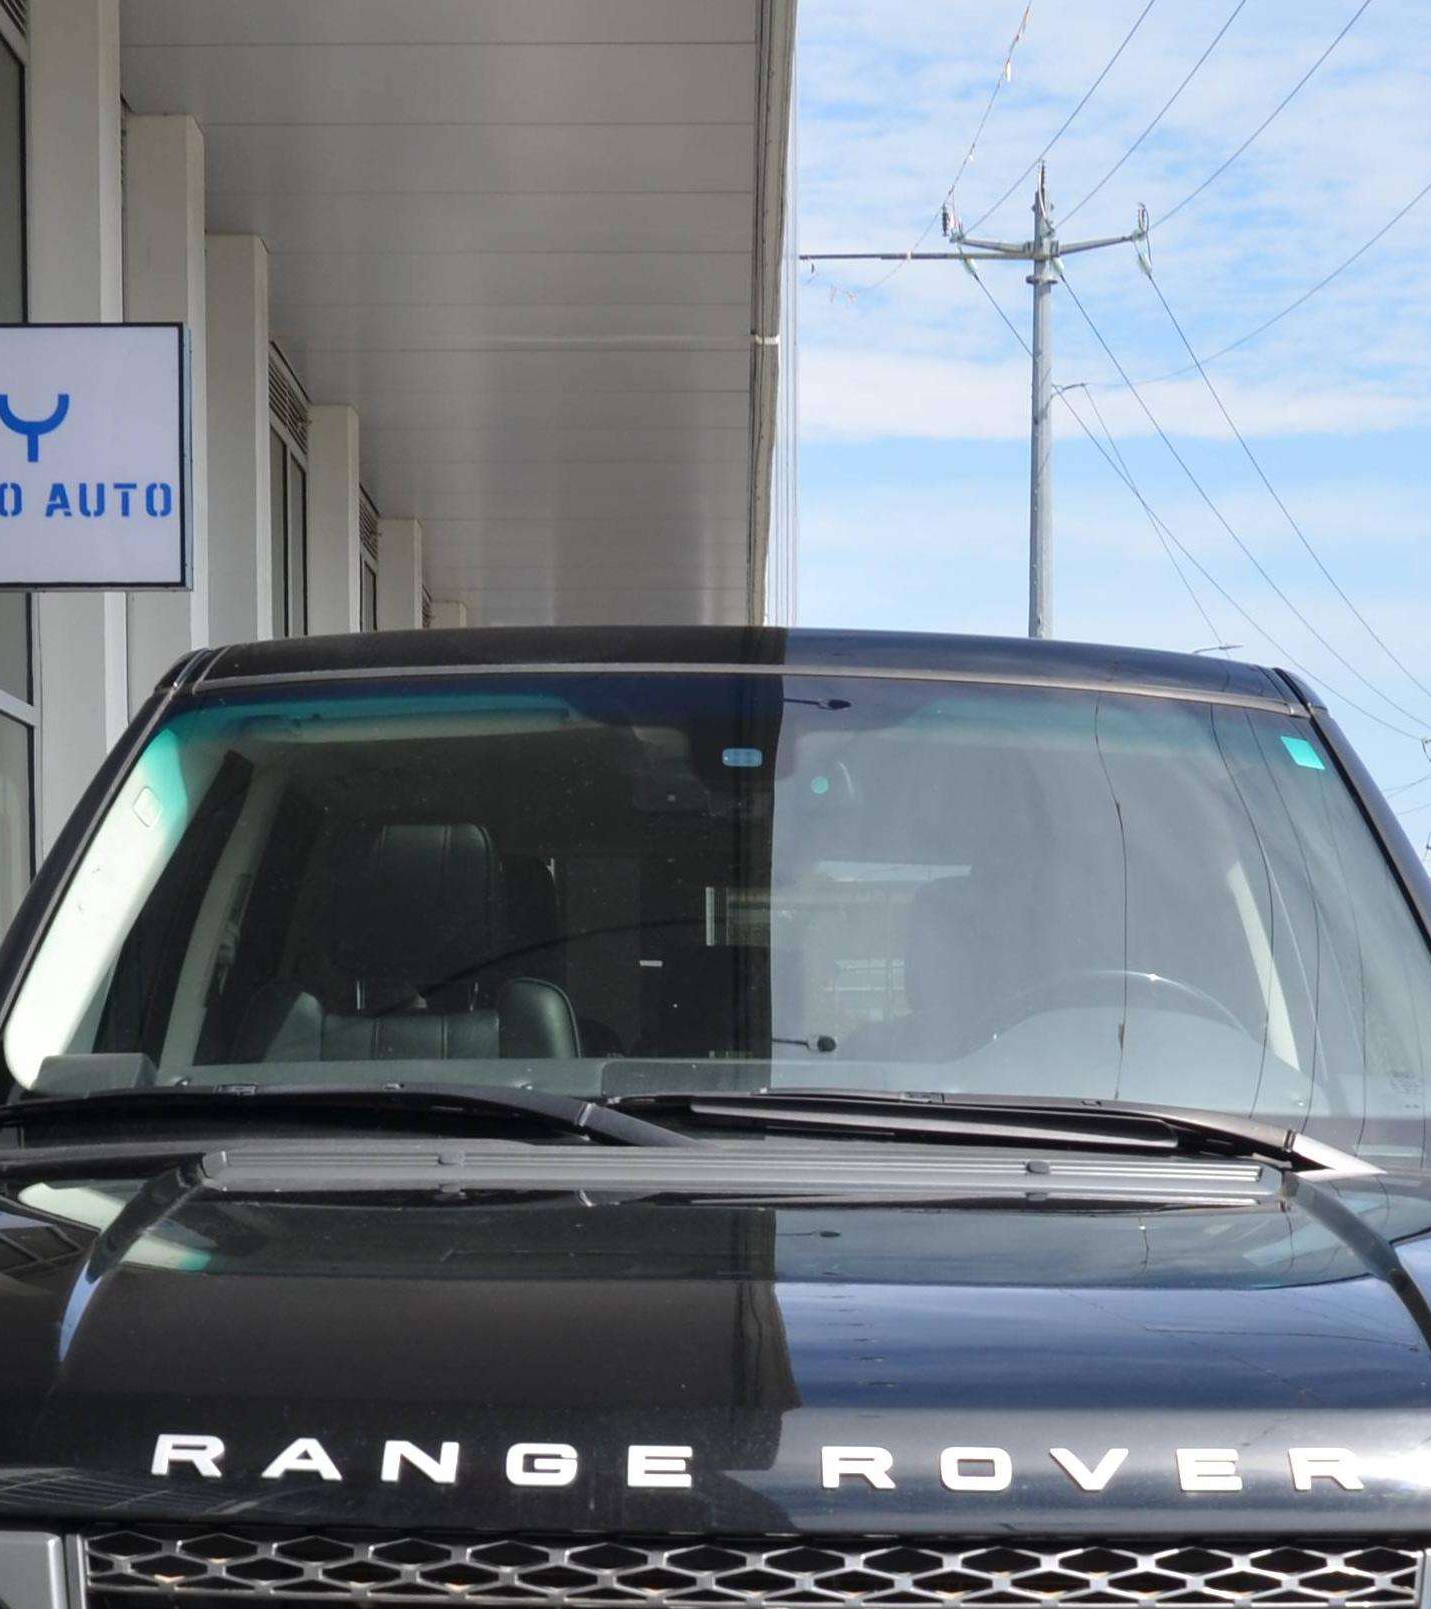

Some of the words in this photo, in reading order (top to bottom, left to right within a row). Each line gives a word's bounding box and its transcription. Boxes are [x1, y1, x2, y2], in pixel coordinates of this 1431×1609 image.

[45, 482, 172, 518] AUTO
[151, 1433, 693, 1488] RANGE
[821, 1446, 1365, 1492] ROVER
